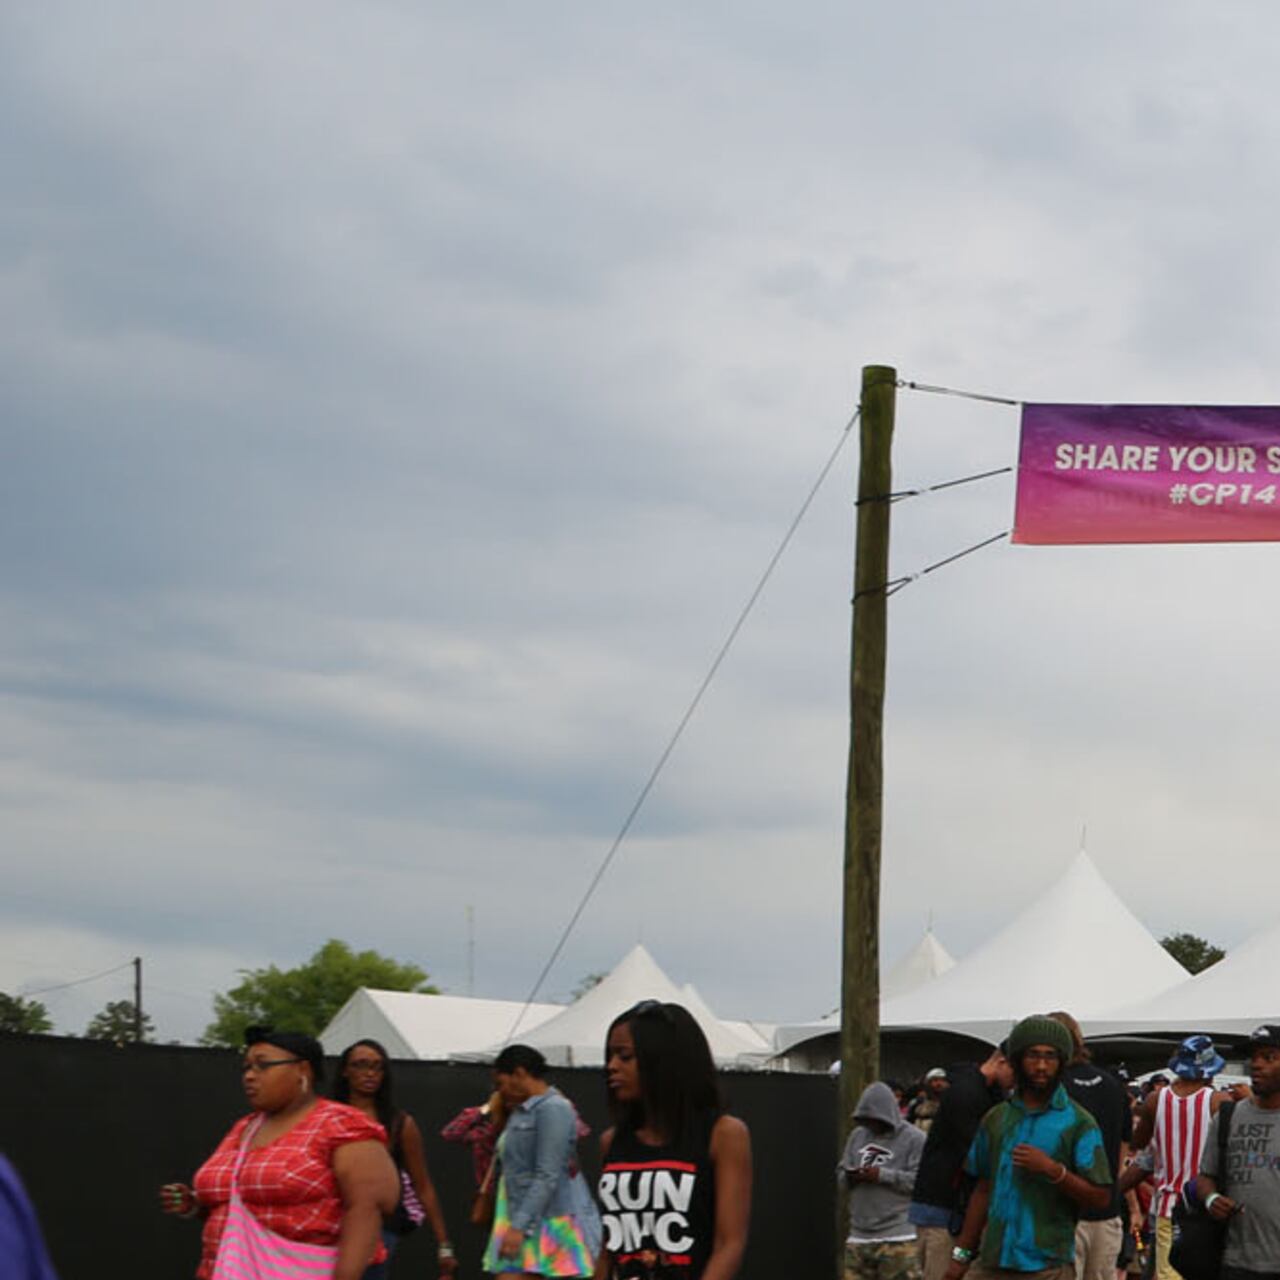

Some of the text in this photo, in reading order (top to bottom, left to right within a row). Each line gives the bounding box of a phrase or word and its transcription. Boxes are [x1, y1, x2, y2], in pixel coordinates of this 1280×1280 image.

[1054, 443, 1160, 472] SHARE
[1169, 445, 1257, 474] YOUR
[1169, 482, 1277, 506] #CP14
[598, 1169, 696, 1213] RUN
